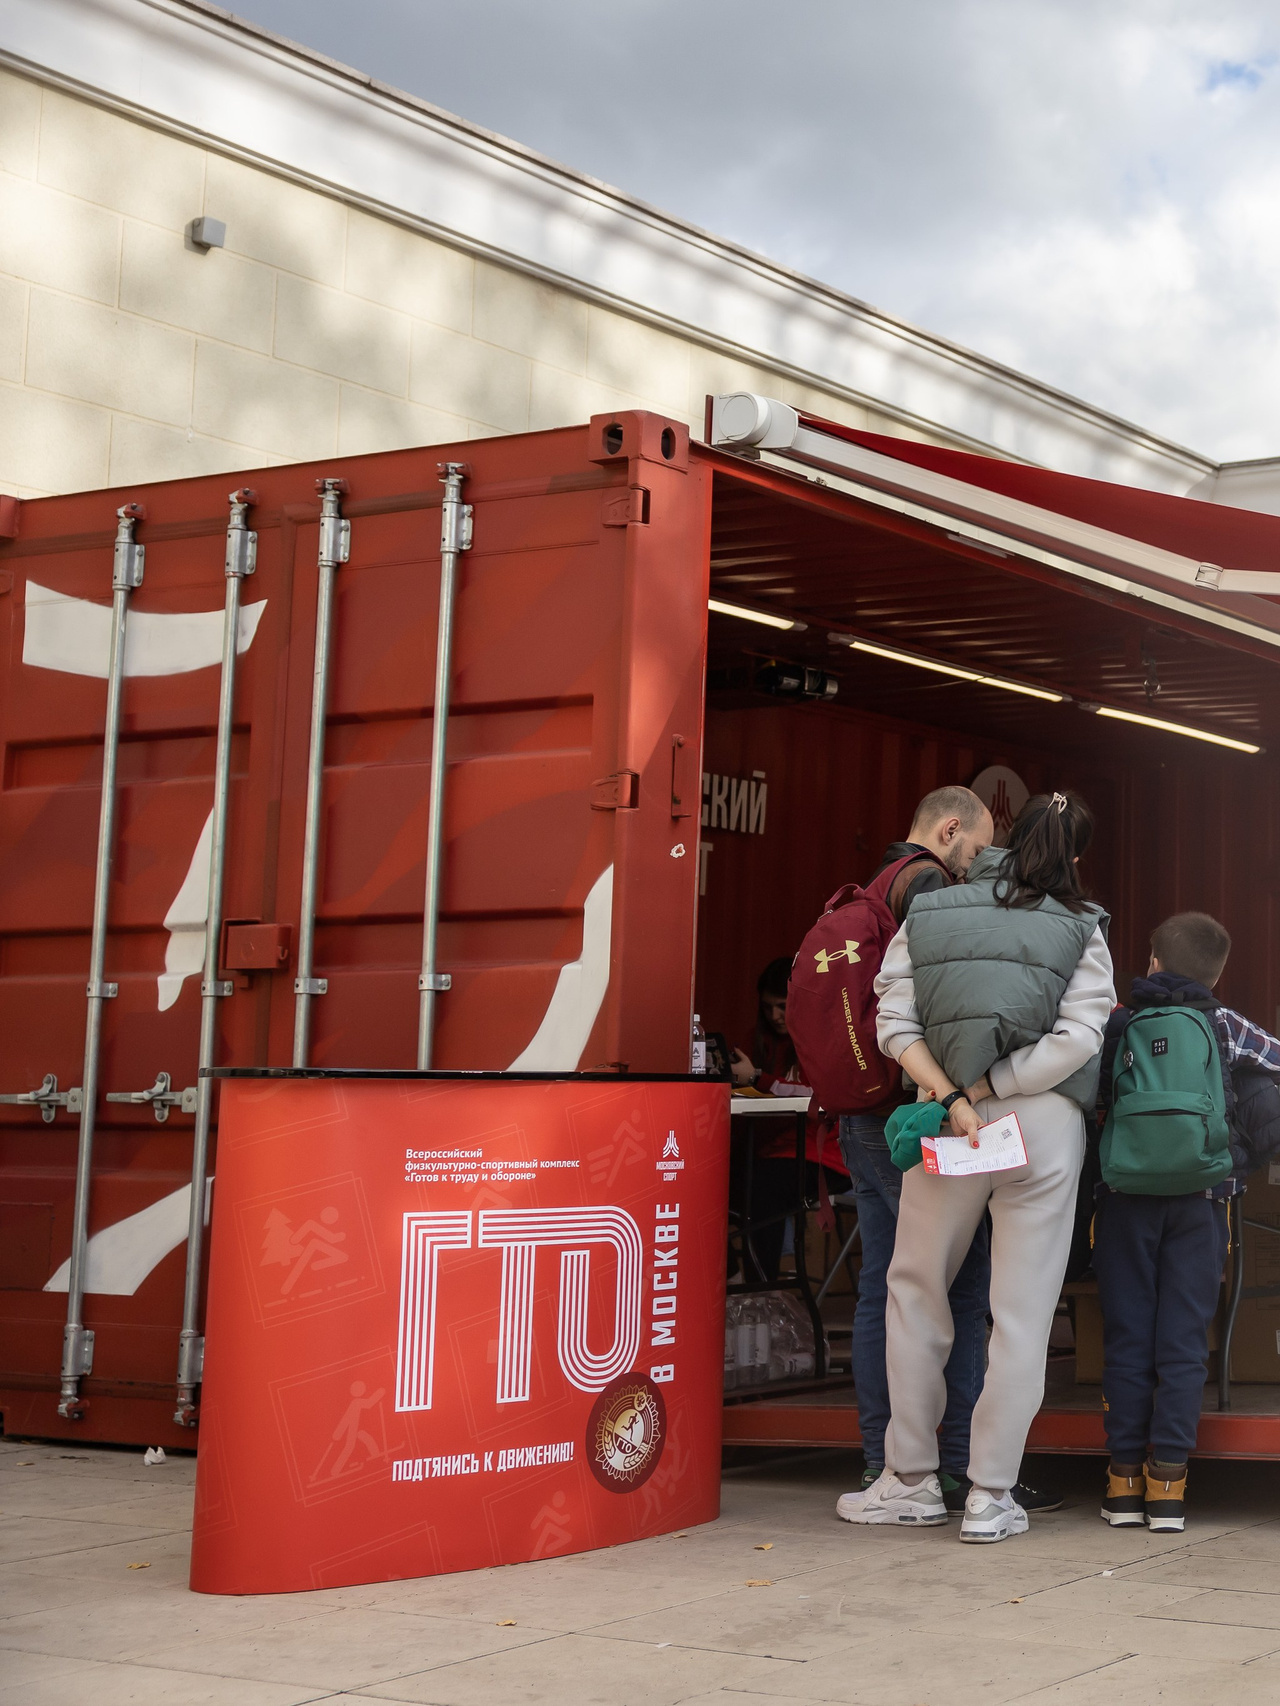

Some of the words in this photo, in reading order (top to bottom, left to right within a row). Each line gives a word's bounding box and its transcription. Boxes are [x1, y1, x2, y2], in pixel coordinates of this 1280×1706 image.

[841, 987, 853, 1024] UNDER
[847, 1024, 867, 1071] ARMOUR
[405, 1149, 483, 1160] Всероссийский
[405, 1159, 538, 1172] физкультурно-спортивный
[540, 1160, 580, 1168] комплекс
[404, 1172, 439, 1182] «Готов
[441, 1173, 447, 1182] к
[450, 1172, 480, 1183] труду
[482, 1173, 488, 1181] и
[491, 1171, 536, 1182] обороне»
[651, 1203, 680, 1346] МОСКВЕ
[395, 1205, 643, 1412] ГТО
[650, 1363, 675, 1383] В
[616, 1437, 633, 1454] ГТО
[392, 1453, 480, 1482] ПОДТЯНИСЬ
[483, 1451, 494, 1472] К
[496, 1441, 575, 1473] ДВИЖЕНИЮ!
